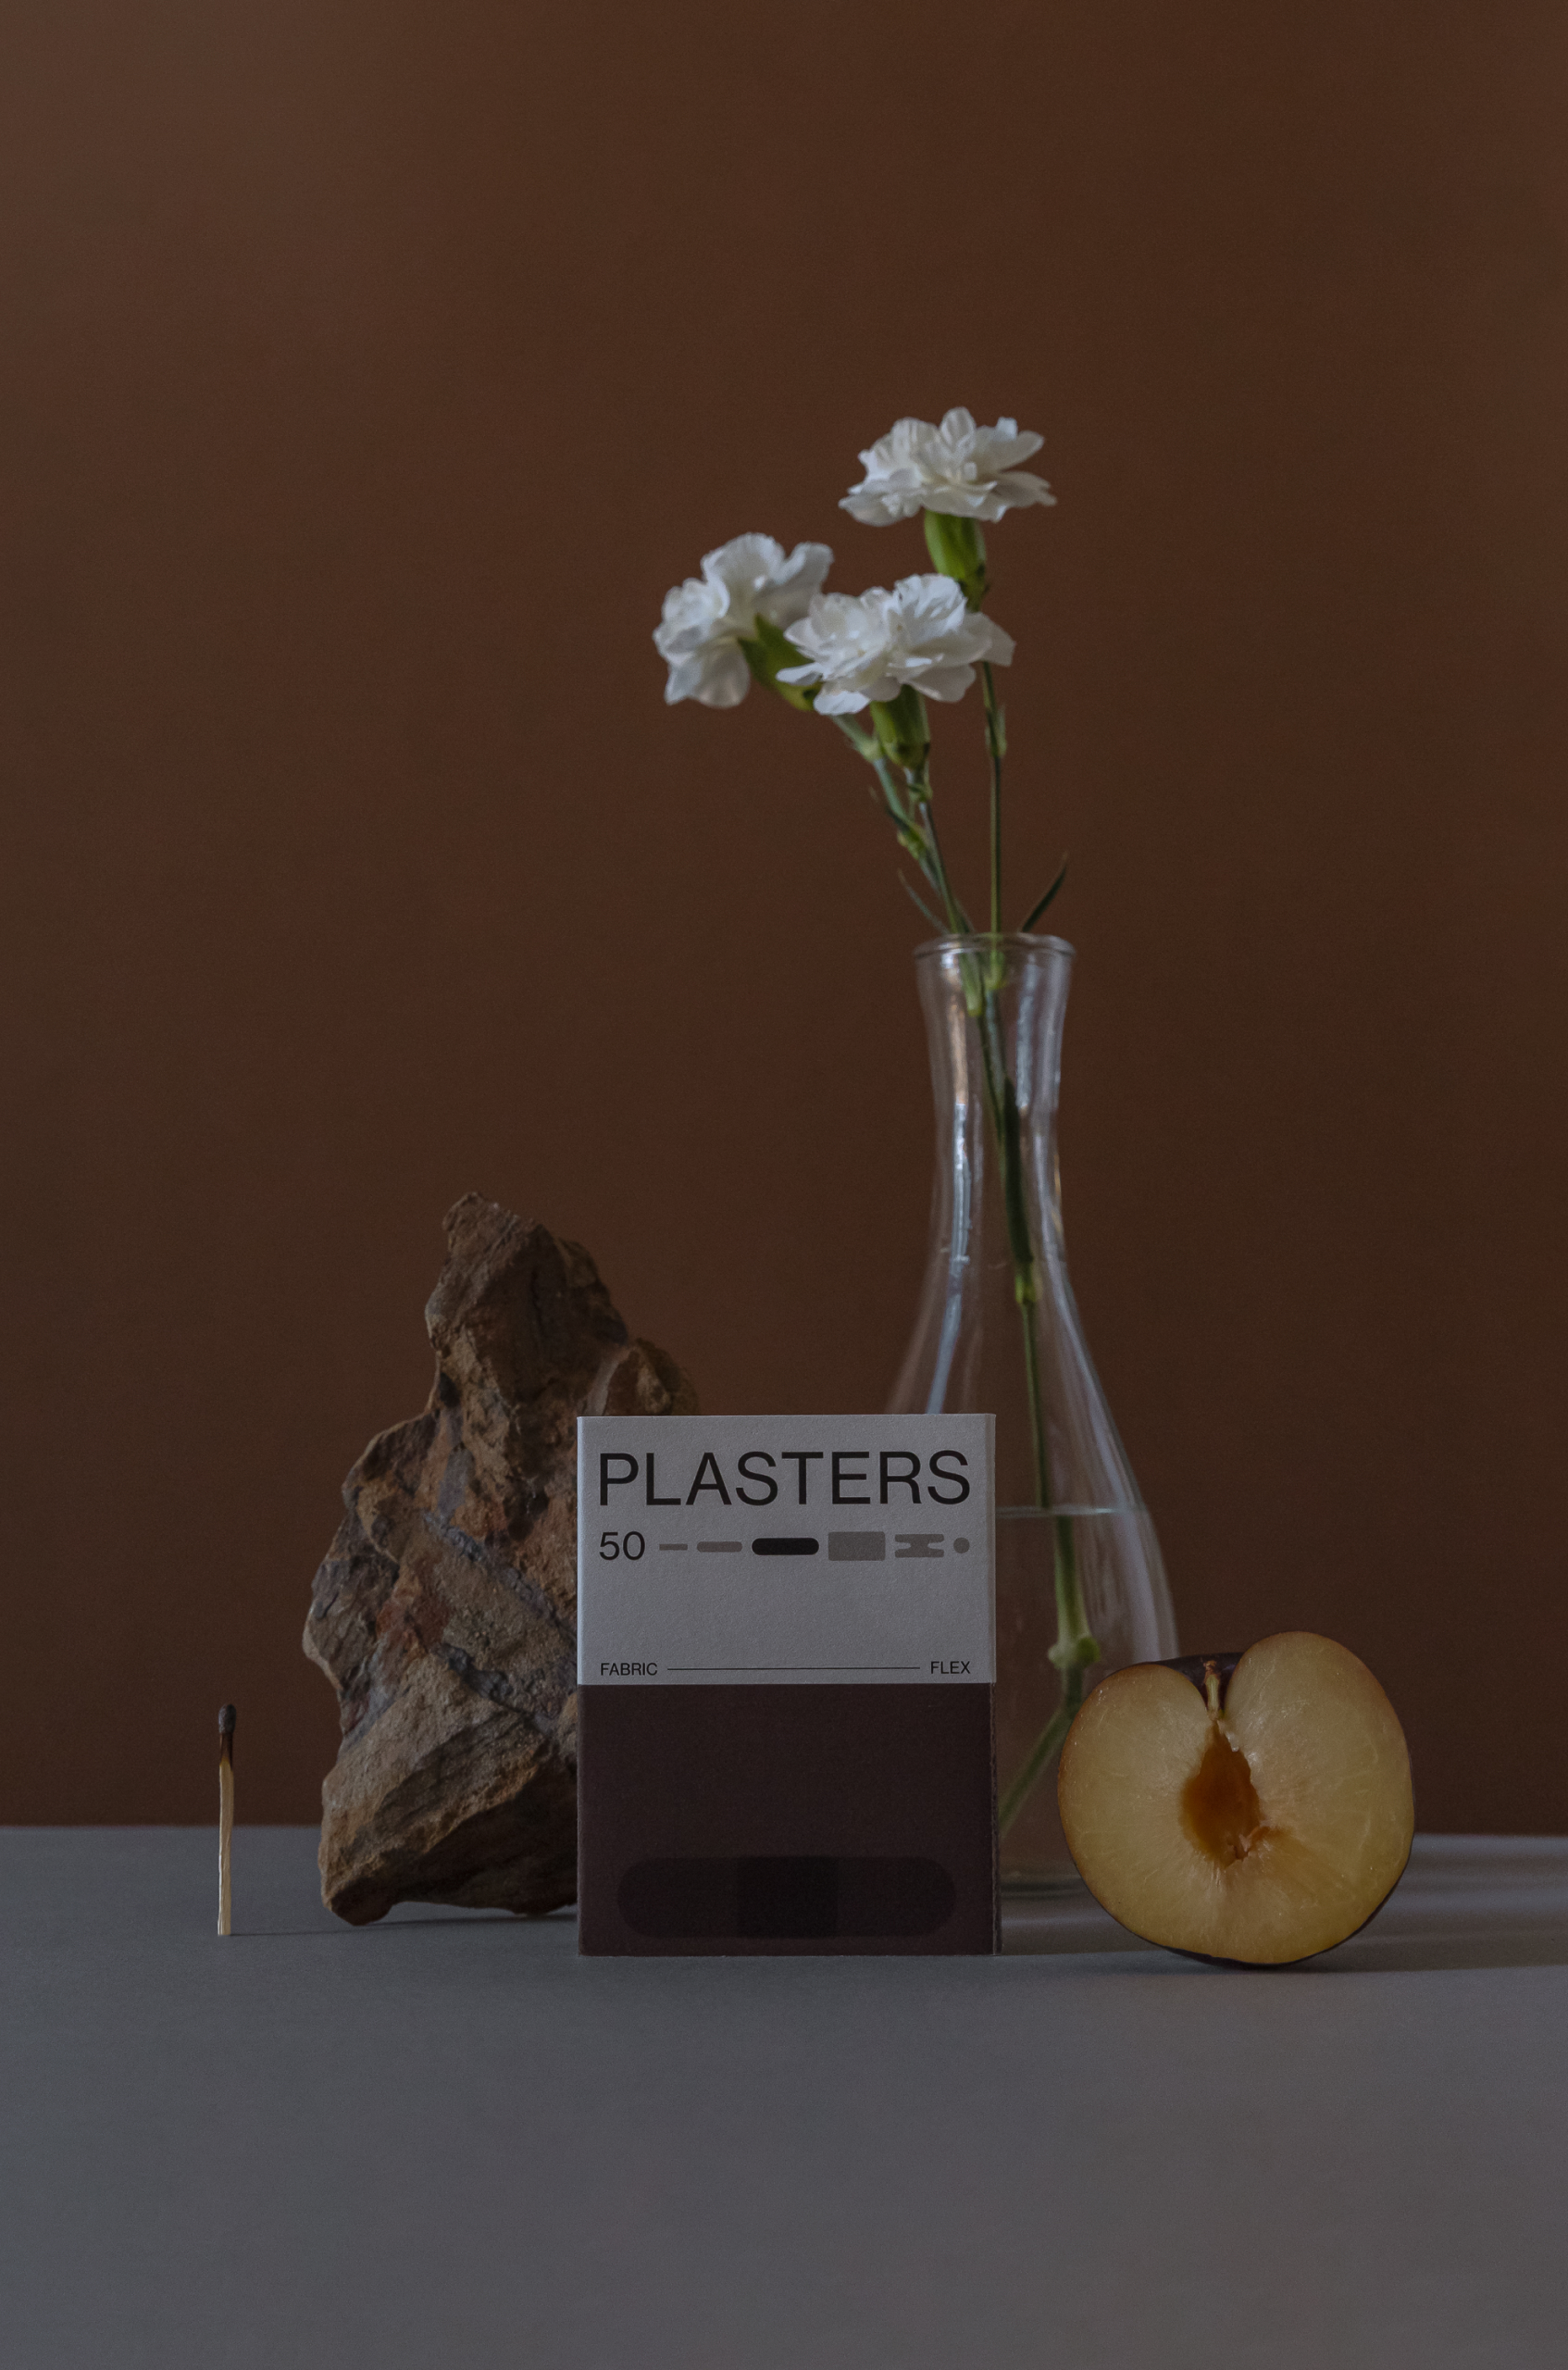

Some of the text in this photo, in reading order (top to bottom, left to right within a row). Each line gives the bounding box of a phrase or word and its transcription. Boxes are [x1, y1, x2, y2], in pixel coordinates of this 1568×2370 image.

[599, 1450, 971, 1506] PLASTERS
[599, 1531, 646, 1561] 50
[600, 1662, 658, 1677] FABRIC
[930, 1660, 971, 1675] FLEX
